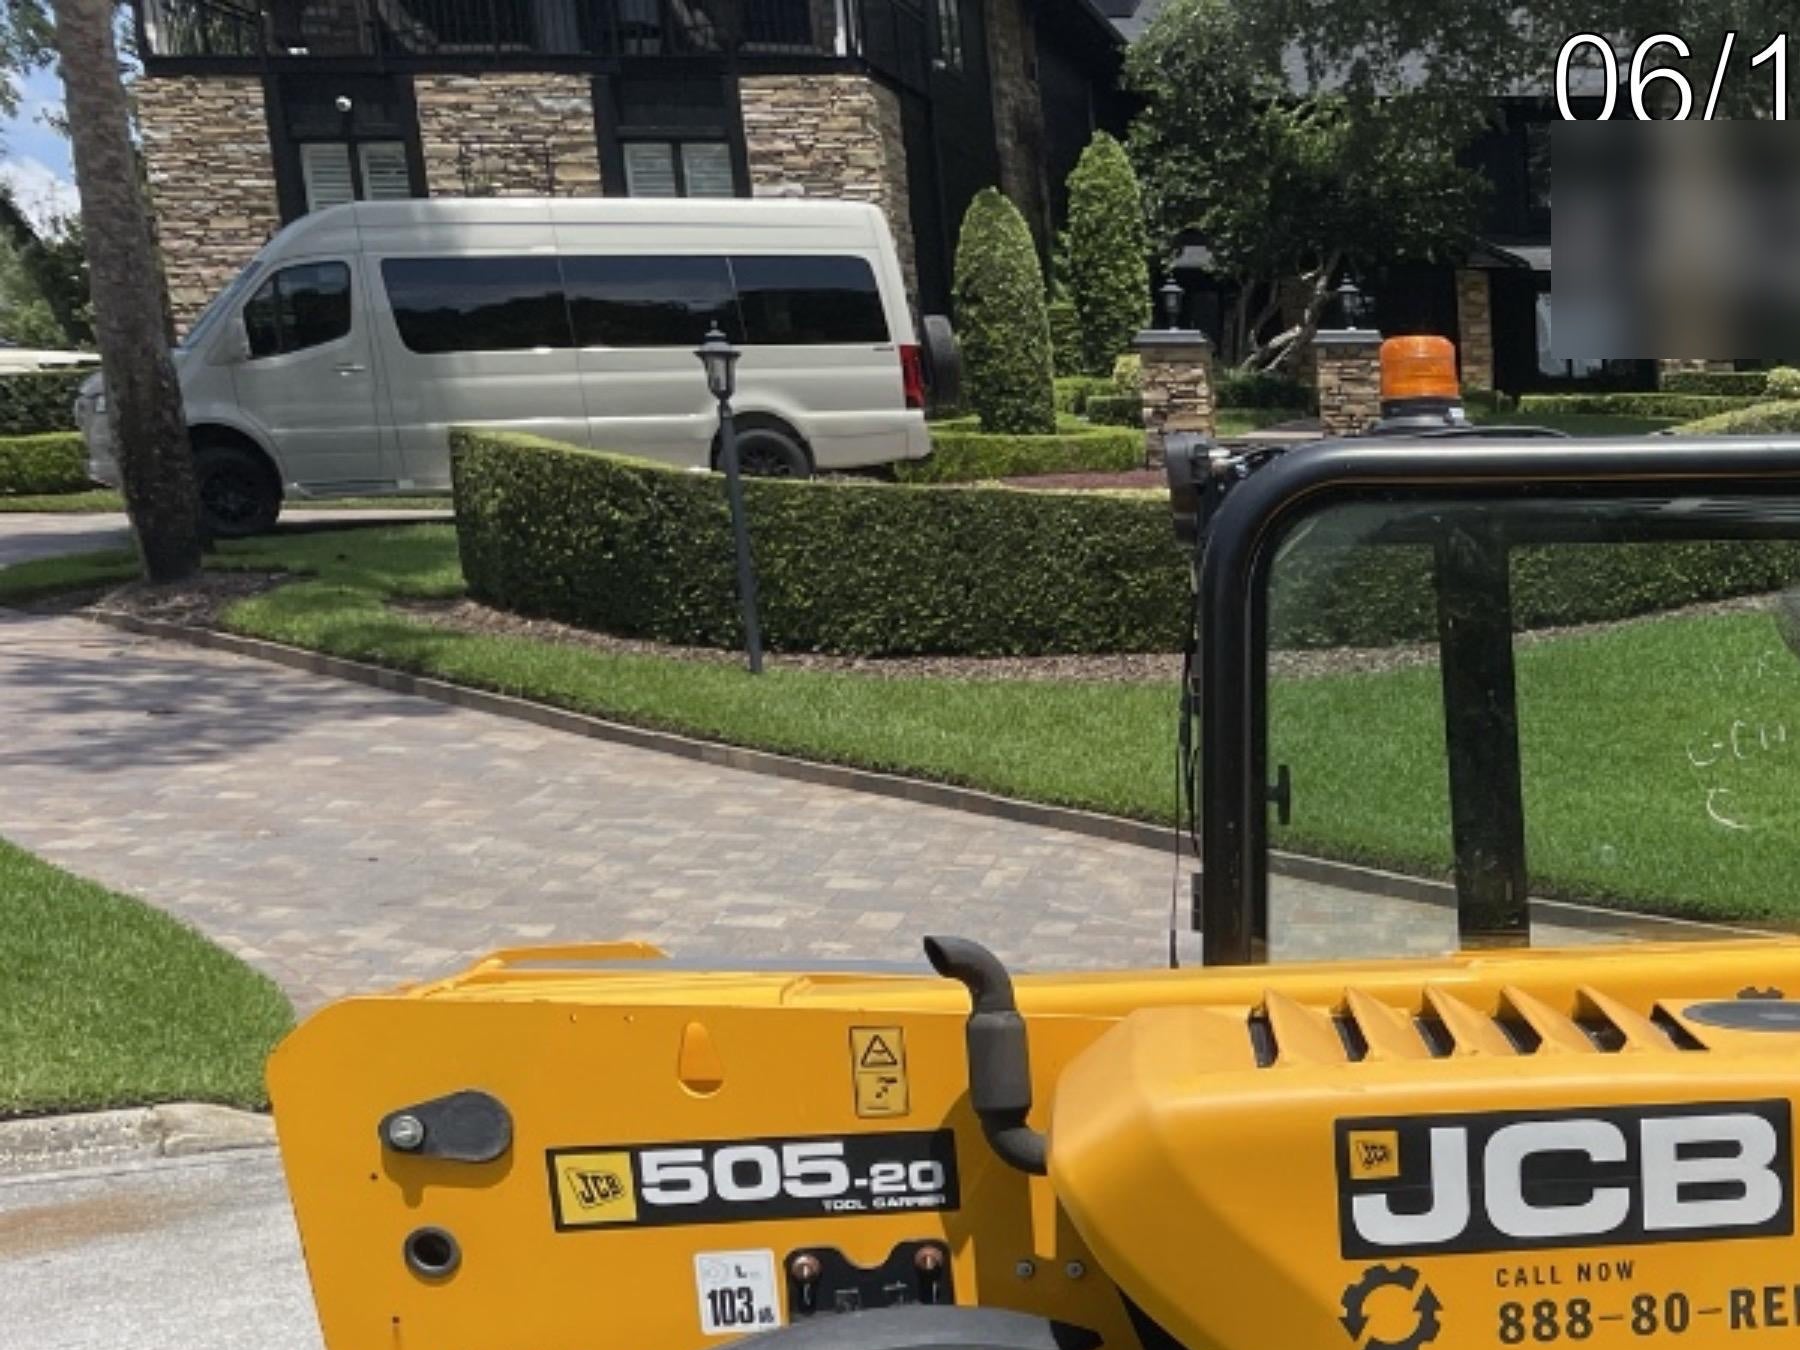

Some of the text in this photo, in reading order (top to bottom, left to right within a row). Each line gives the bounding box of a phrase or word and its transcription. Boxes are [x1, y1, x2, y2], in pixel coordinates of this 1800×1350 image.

[575, 1171, 624, 1204] JCB
[640, 1142, 944, 1205] 505-20
[1352, 1113, 1783, 1246] JCB
[1496, 1259, 1635, 1287] CALL NOW
[707, 1286, 755, 1327] 103
